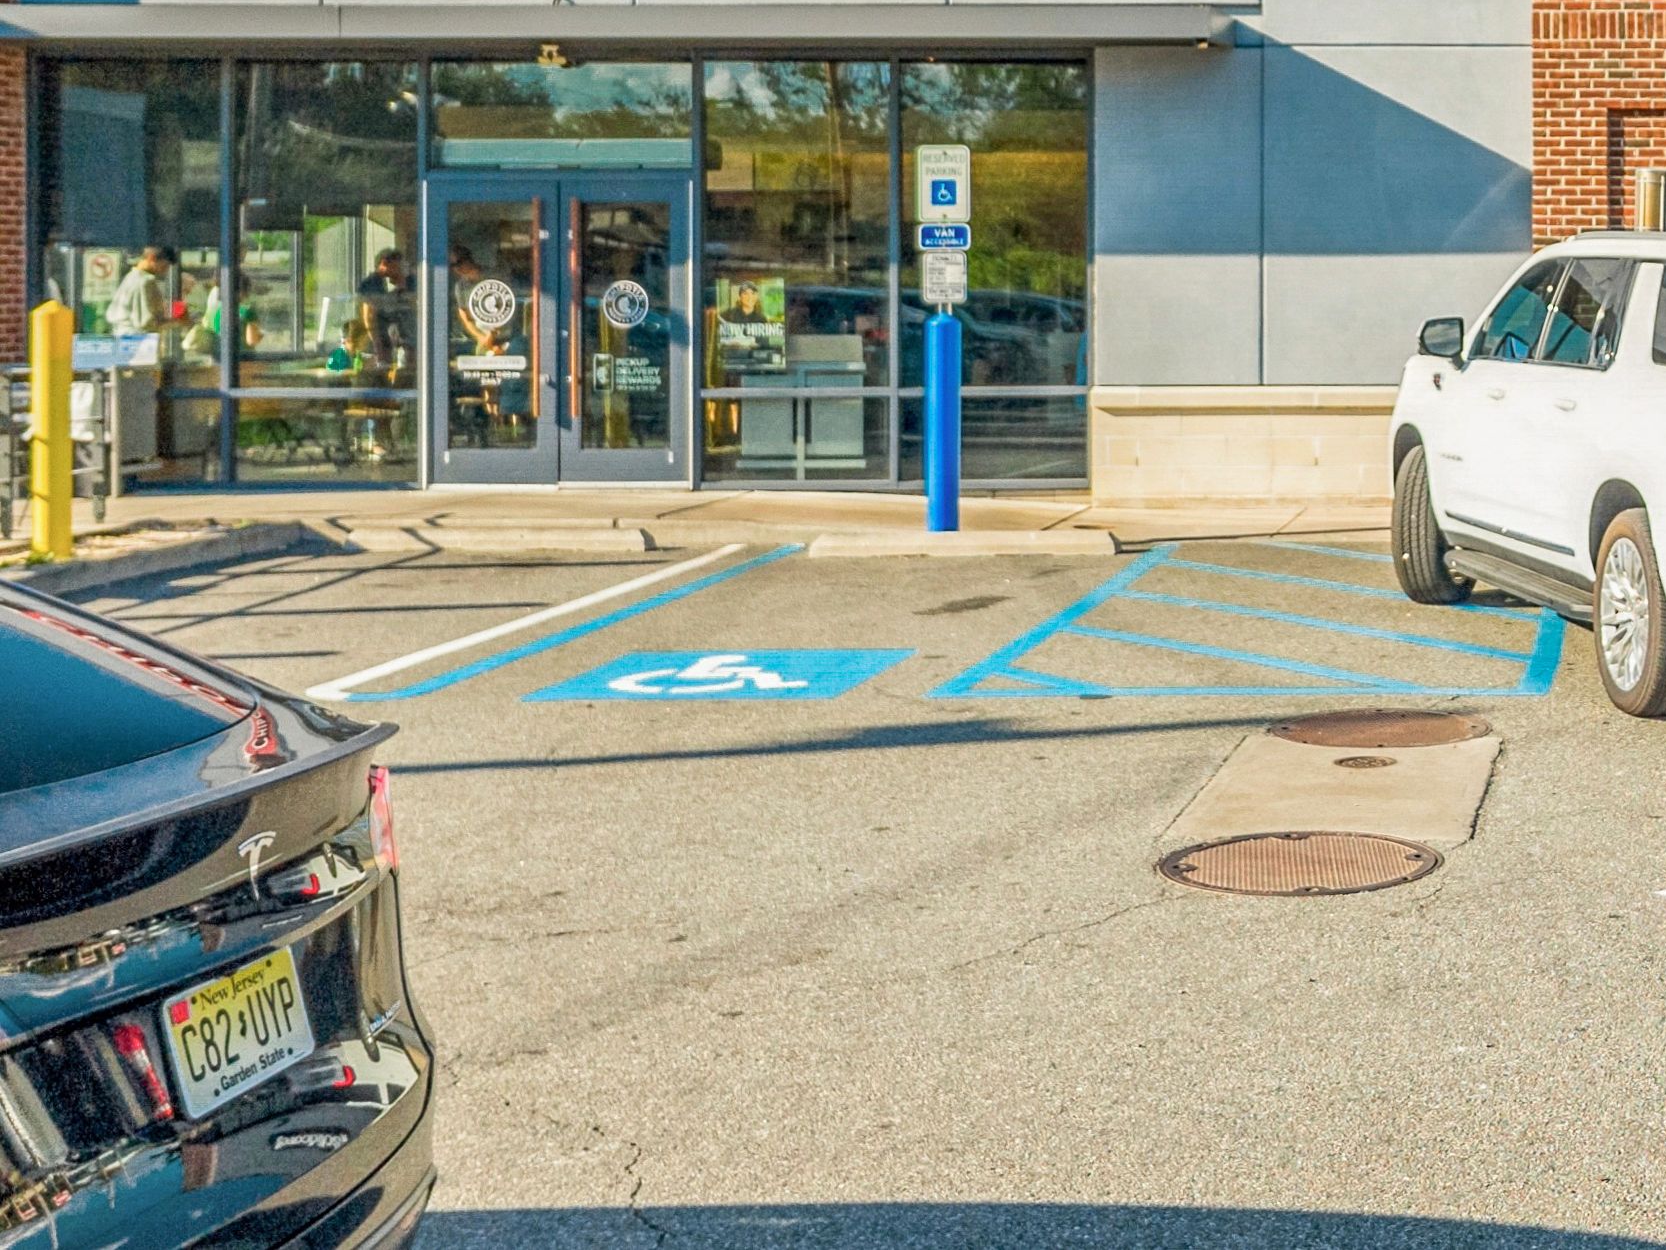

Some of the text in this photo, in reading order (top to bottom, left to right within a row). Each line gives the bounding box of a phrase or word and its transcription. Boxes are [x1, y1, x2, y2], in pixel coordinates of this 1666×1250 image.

[922, 153, 966, 164] RESERVED
[925, 166, 963, 176] PARKING
[933, 228, 956, 238] VAN
[719, 322, 785, 338] NOW HIRING
[199, 969, 266, 1009] New Jersey
[181, 1008, 240, 1083] C82
[245, 976, 295, 1046] UYP
[220, 1047, 286, 1091] Garden State
